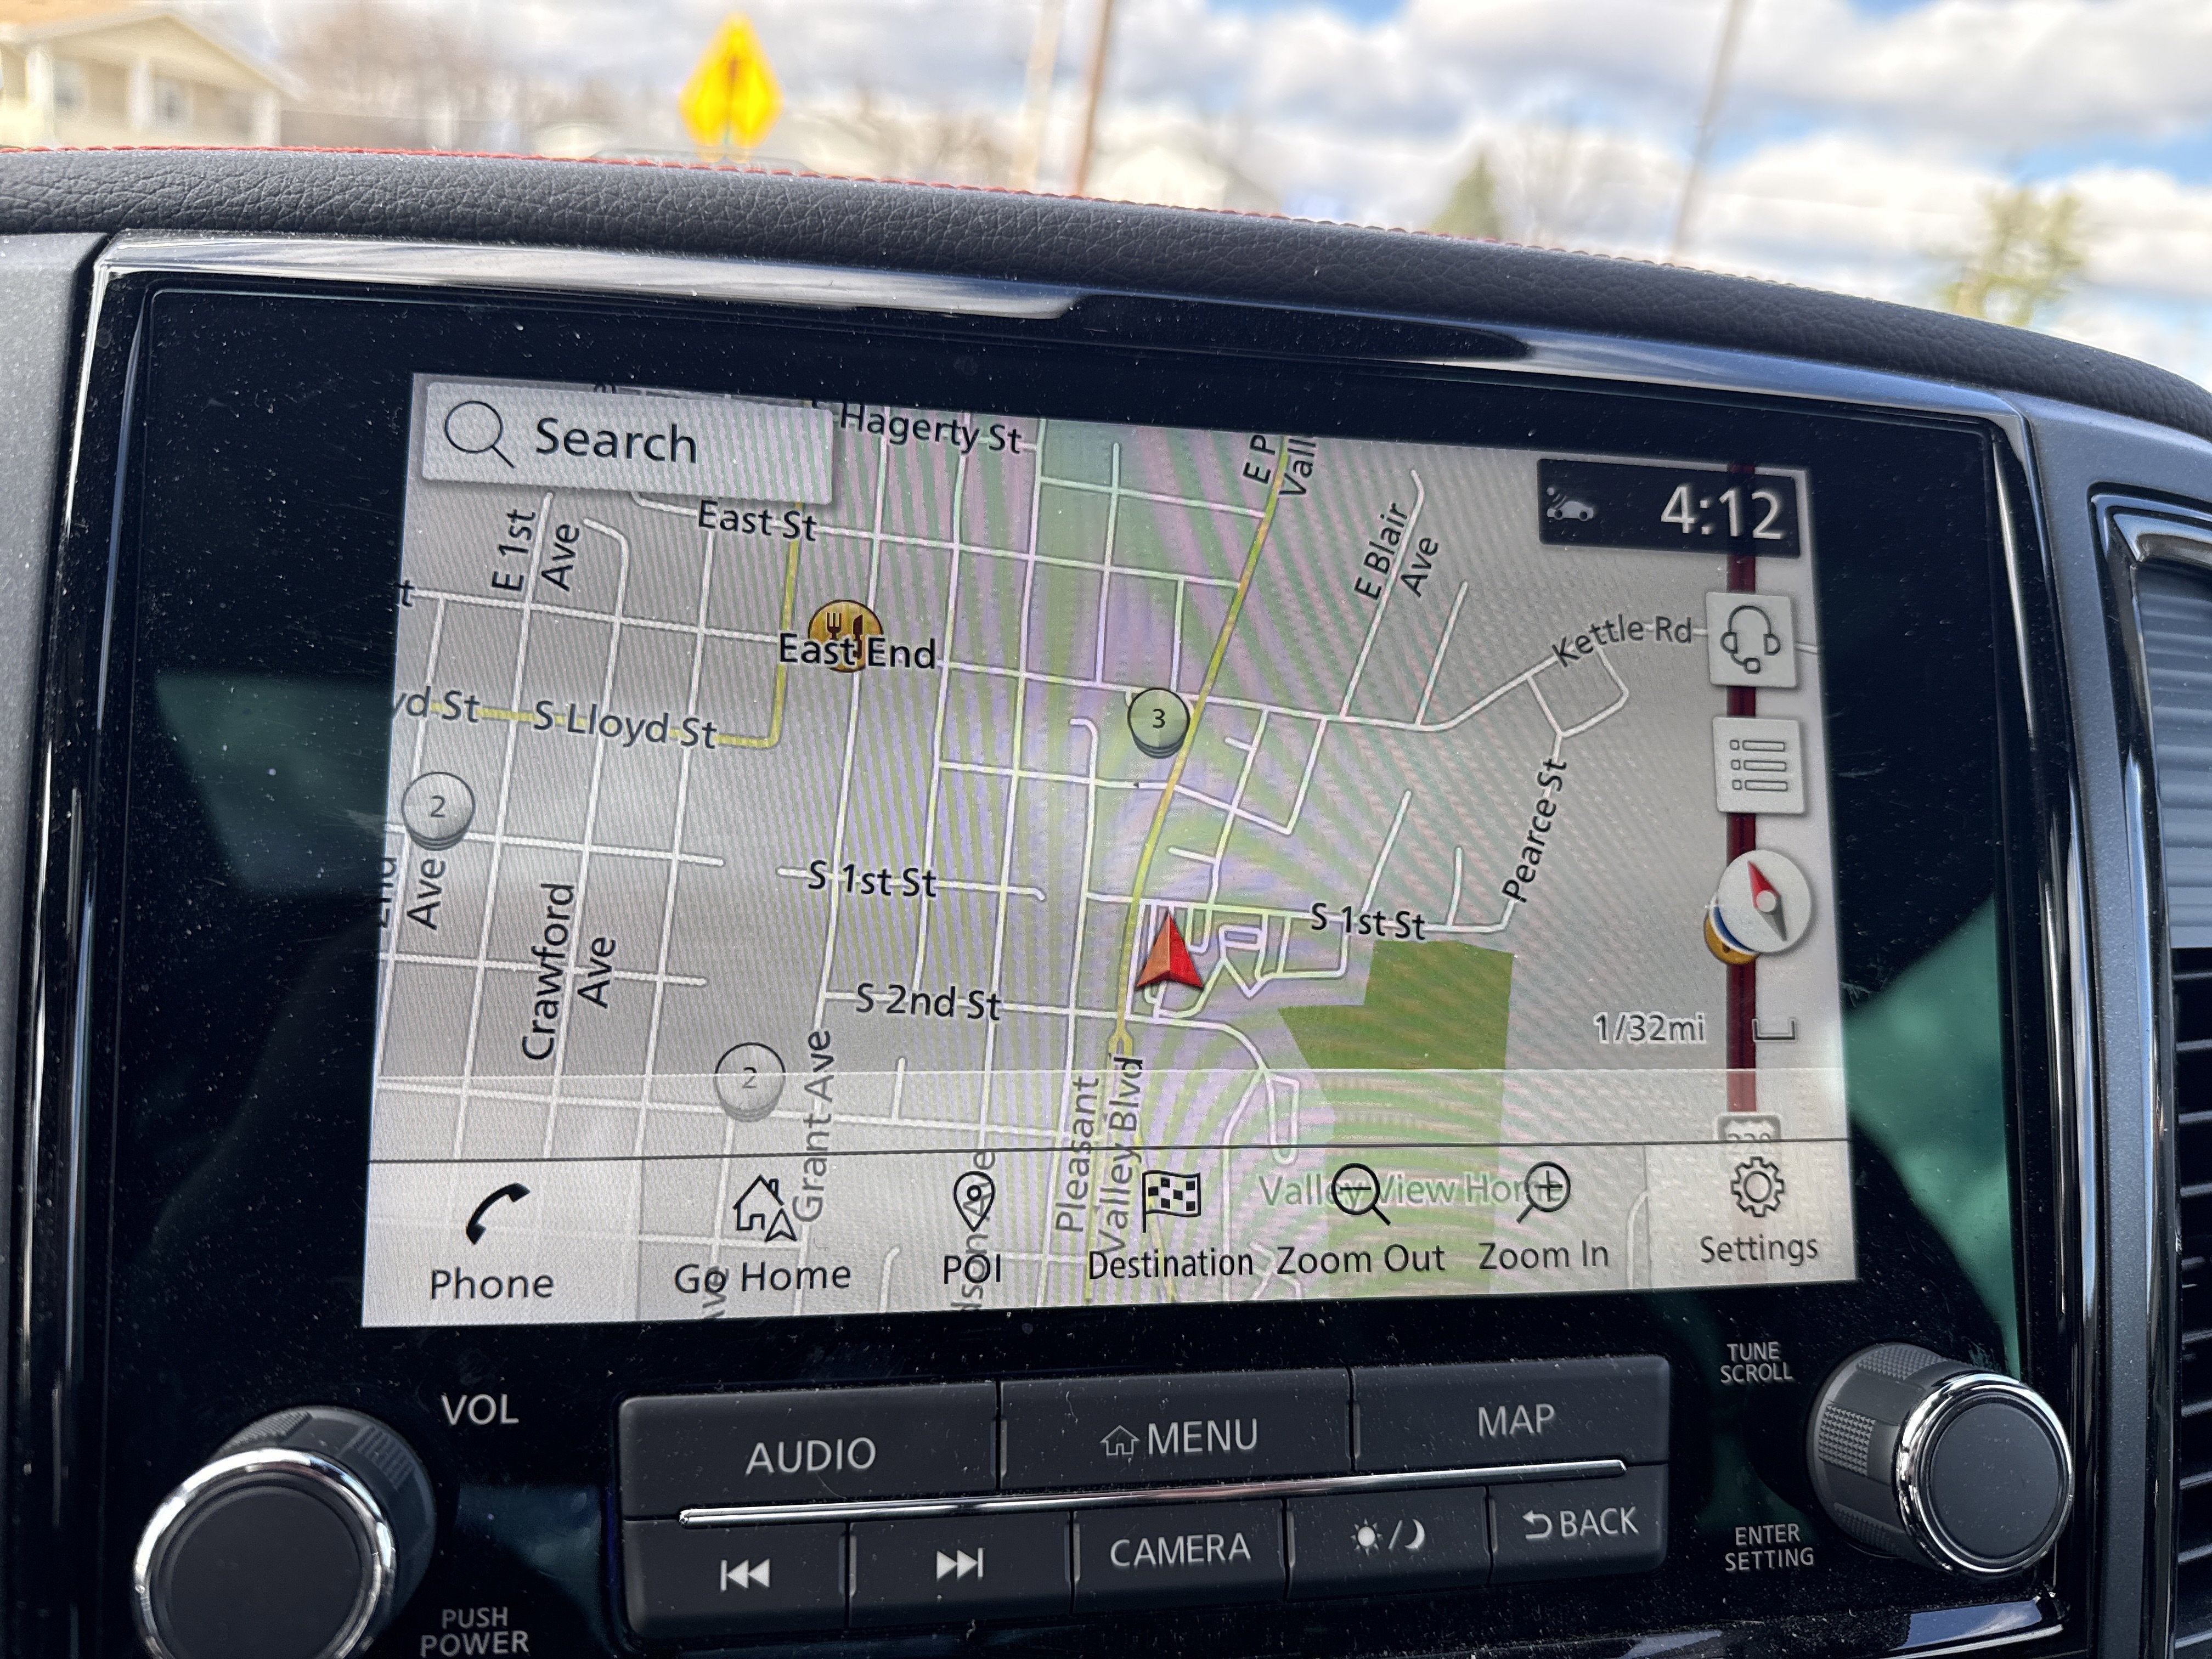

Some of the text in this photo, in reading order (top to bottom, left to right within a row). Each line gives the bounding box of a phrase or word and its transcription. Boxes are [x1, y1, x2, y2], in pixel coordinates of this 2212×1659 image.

[537, 417, 697, 463] Search
[840, 403, 1022, 454] Hagerty St
[1243, 462, 1271, 484] E
[698, 500, 818, 541] East St
[1661, 483, 1783, 539] 4:12
[492, 510, 536, 591] E 1st
[541, 524, 580, 591] Ave
[1355, 503, 1409, 600] E Blair
[1400, 537, 1440, 597] Ave
[779, 633, 935, 669] East End
[1551, 614, 1692, 668] Kettle Rd
[442, 690, 480, 723] St
[1152, 709, 1166, 729] 3
[534, 701, 717, 749] S Lloyd St
[431, 795, 445, 818] 2
[1502, 757, 1566, 902] Pearce St
[407, 858, 446, 930] Ave
[808, 860, 936, 898] S 1st St
[1311, 902, 1426, 940] S 1st St
[521, 882, 574, 1060] Crawford
[577, 937, 616, 1009] Ave
[856, 984, 1001, 1020] S 2nd St
[1595, 1013, 1705, 1043] 1/32mi
[742, 1066, 757, 1089] 2
[792, 1030, 834, 1222] Grant Ave
[1055, 1076, 1099, 1233] Pleasant
[1099, 1057, 1143, 1254] Valley Blvd
[1378, 1175, 1456, 1204] View
[1089, 1247, 1253, 1279] Destination
[1277, 1243, 1446, 1276] Zoom Out
[1479, 1240, 1608, 1270] Zoom In
[1700, 1233, 1818, 1267] Settings
[432, 1267, 554, 1300] Phone
[675, 1262, 851, 1294] Go Home
[944, 1253, 1002, 1284] POI
[1726, 1341, 1780, 1361] TUNE
[1720, 1362, 1793, 1385] SCROLL
[441, 1393, 519, 1426] VOL
[1477, 1403, 1556, 1437] MAP
[1148, 1418, 1258, 1456] MENU
[745, 1437, 876, 1476] AUDIO
[1559, 1506, 1639, 1538] BACK
[1734, 1523, 1801, 1547] ENTER
[1110, 1532, 1251, 1567] CAMERA
[1725, 1547, 1814, 1573] SETTING
[441, 1607, 508, 1629] PUSH
[420, 1630, 530, 1658] POWER
